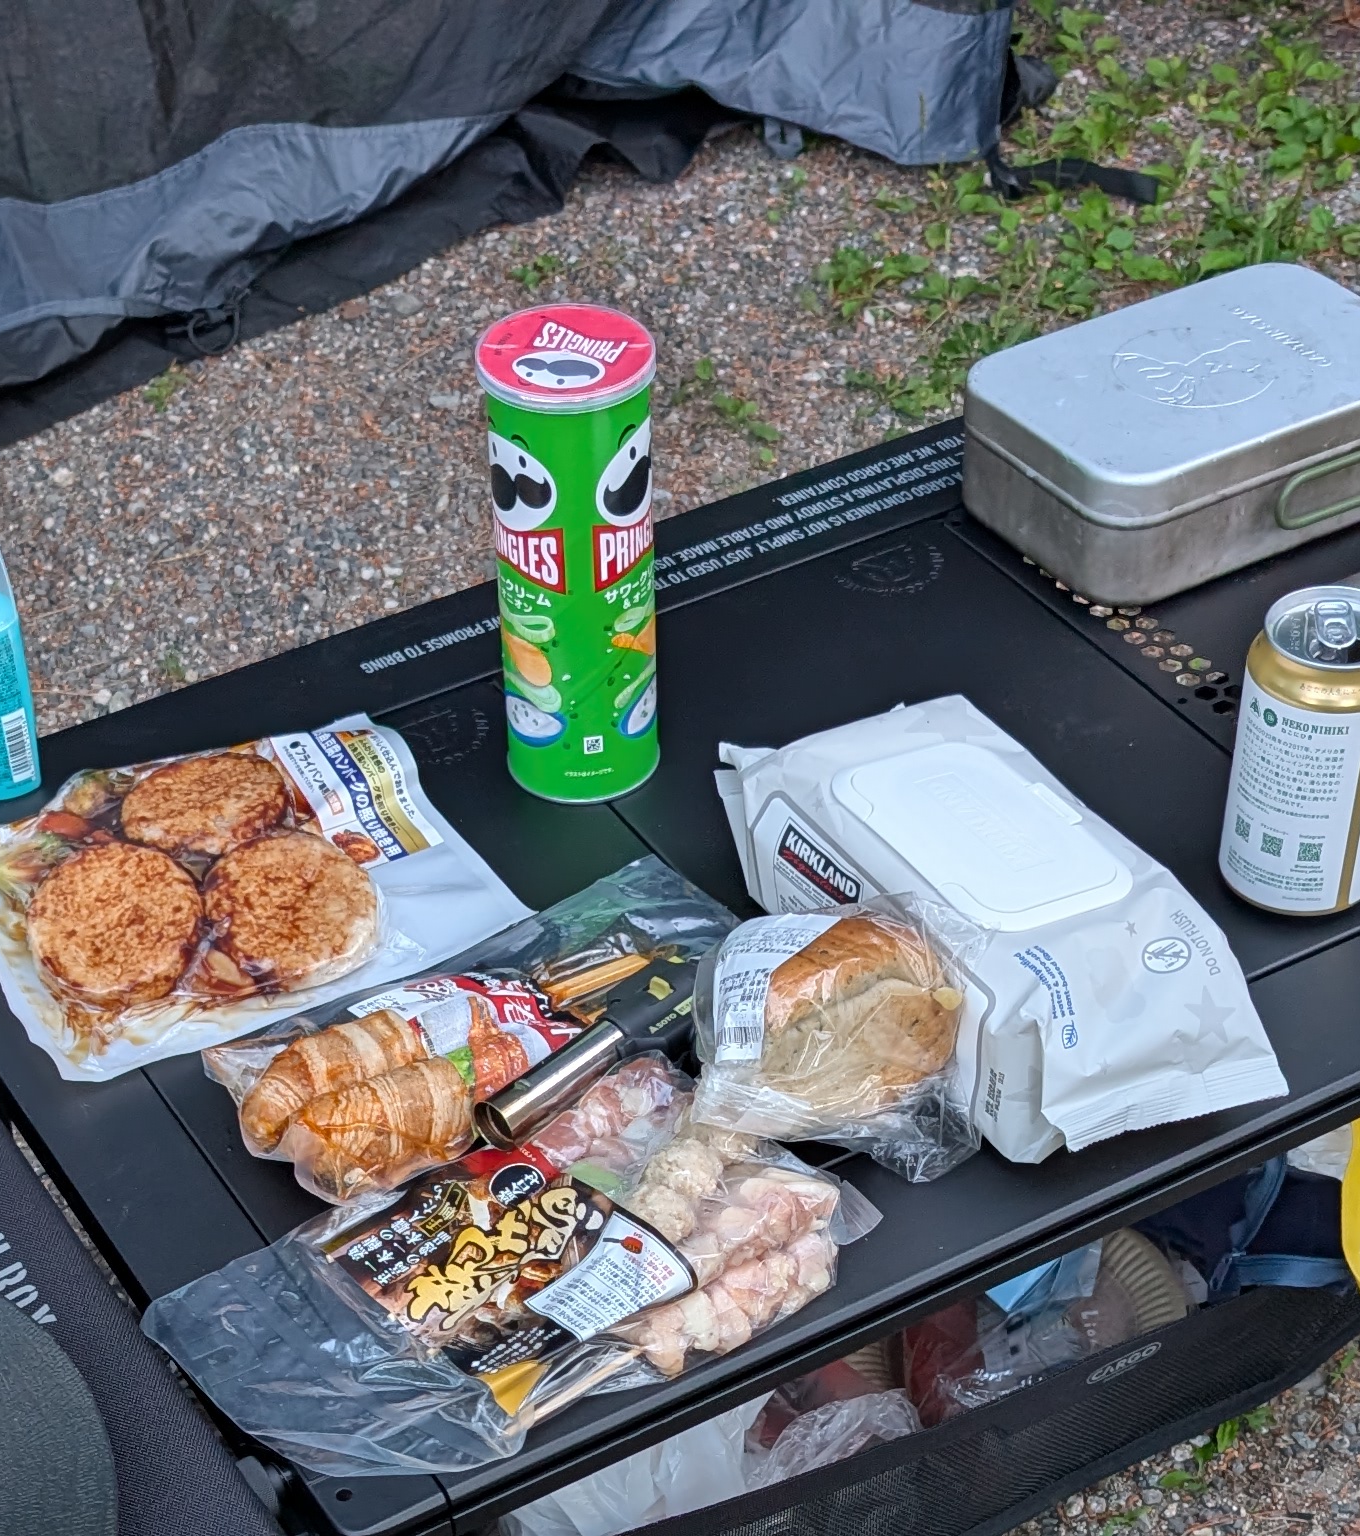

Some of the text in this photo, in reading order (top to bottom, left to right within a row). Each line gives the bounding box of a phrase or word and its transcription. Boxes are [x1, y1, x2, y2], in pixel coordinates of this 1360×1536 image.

[533, 321, 629, 364] PRINGLES
[887, 450, 913, 470] ARE
[912, 443, 936, 461] WE
[922, 452, 959, 475] THUS
[845, 459, 890, 485] CARGO
[851, 465, 924, 501] DISPLAYING
[840, 490, 852, 505] A
[910, 474, 955, 499] CARGO
[792, 494, 842, 522] STURDY
[842, 488, 912, 524] CONTAINER
[764, 512, 792, 532] AND
[803, 517, 829, 537] NOT
[827, 512, 845, 528] IS
[715, 520, 767, 549] STABLE
[754, 526, 804, 555] SIMPLY
[684, 555, 722, 579] USED
[720, 545, 753, 567] JUST
[667, 568, 688, 586] TO
[403, 642, 426, 660] TO
[421, 621, 485, 654] PROMISE
[358, 648, 406, 675] BRING
[1281, 727, 1312, 740] ねこにひき
[1282, 717, 1350, 735] NEKO NIHIKI
[1298, 833, 1326, 841] Instagram
[785, 830, 858, 898] KIRKLAND
[1170, 909, 1221, 976] DO NOT FLUSH
[1025, 948, 1056, 979] ultra-soft
[1053, 961, 1075, 1016] plant-based
[1055, 990, 1066, 1018] water
[655, 1013, 678, 1029] SOTO
[498, 1171, 540, 1204] 盛合せ
[347, 1185, 442, 1262] 熟練の職人たち
[373, 1232, 451, 1286] 至高の逸品
[407, 1188, 604, 1330] 焼き鳥
[1090, 1345, 1153, 1382] CARGO
